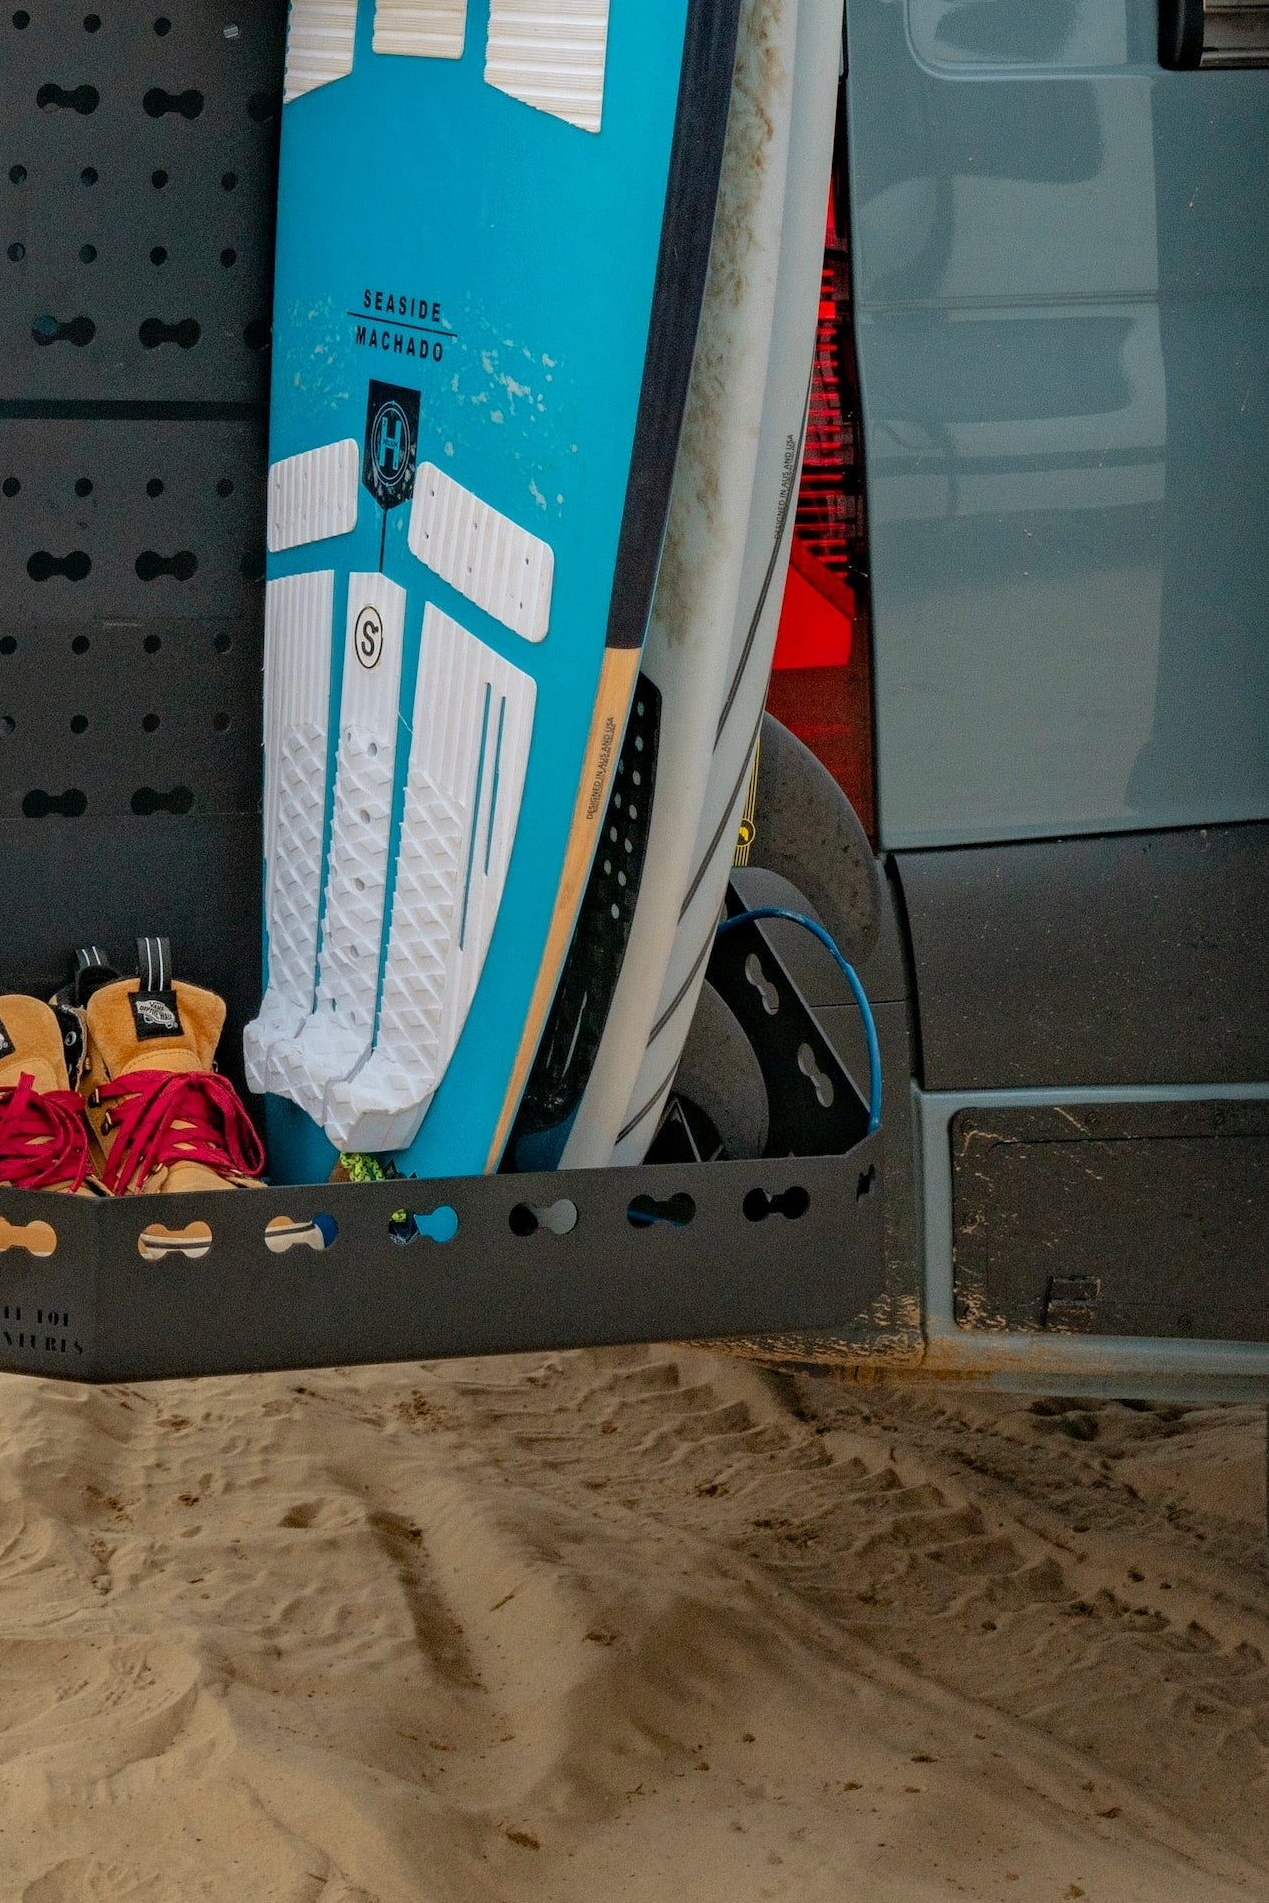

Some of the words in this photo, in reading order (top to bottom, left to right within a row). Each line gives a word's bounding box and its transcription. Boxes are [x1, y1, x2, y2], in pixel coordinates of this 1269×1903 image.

[363, 289, 442, 323] SEASIDE
[355, 326, 443, 362] MACHADO
[786, 434, 794, 451] USA
[783, 450, 792, 469] AND
[781, 469, 789, 487] AUS
[605, 717, 614, 733] USA
[601, 734, 610, 753] AND
[598, 753, 606, 771] AUS
[596, 770, 603, 780] IN
[586, 781, 600, 820] DESIGNED
